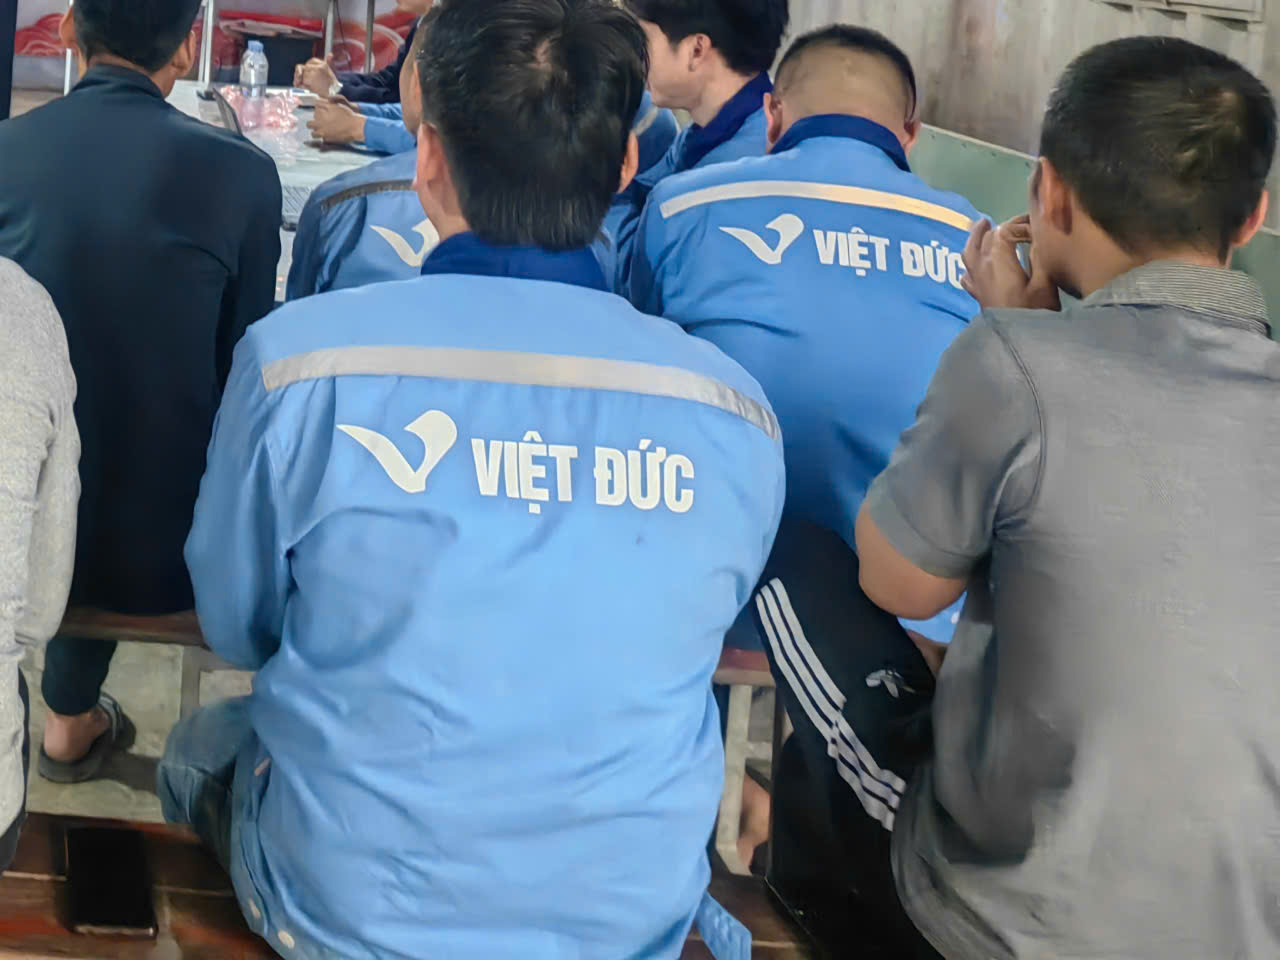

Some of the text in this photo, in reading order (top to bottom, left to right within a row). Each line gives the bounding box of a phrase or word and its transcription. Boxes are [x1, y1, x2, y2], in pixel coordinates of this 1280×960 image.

[813, 226, 967, 290] VIỆT ĐỨC
[471, 430, 695, 514] VIỆT ĐỨC
